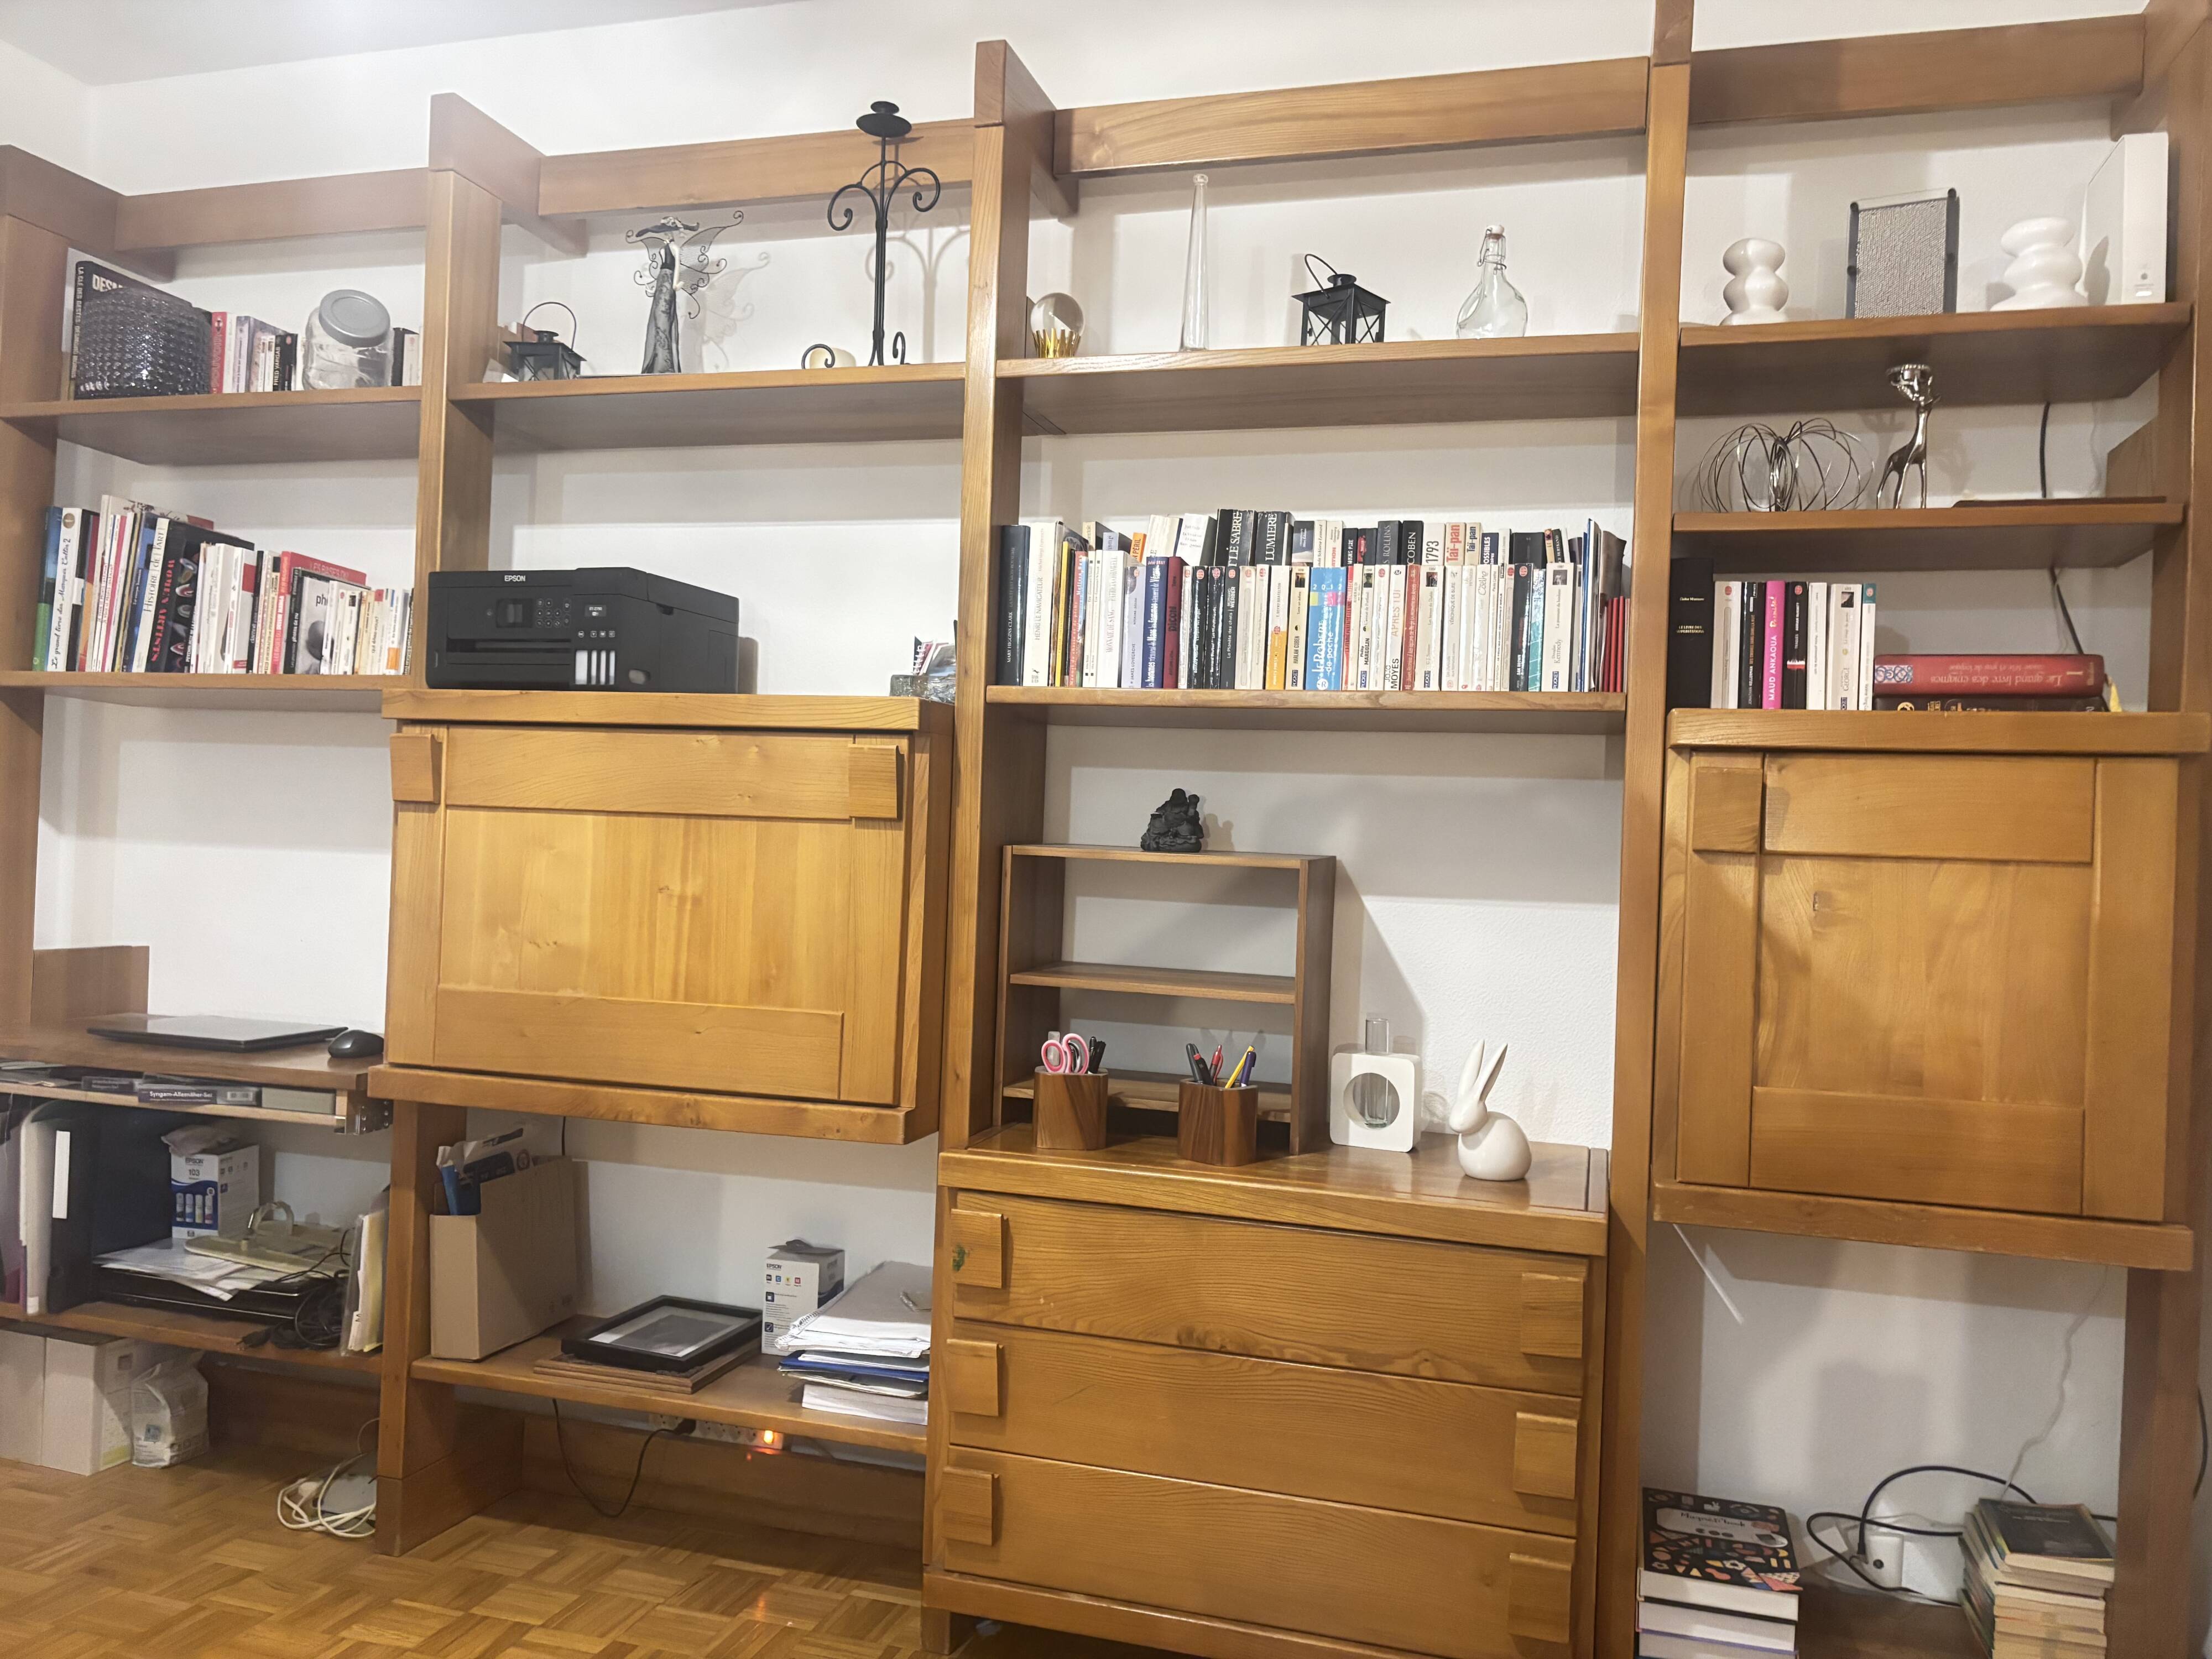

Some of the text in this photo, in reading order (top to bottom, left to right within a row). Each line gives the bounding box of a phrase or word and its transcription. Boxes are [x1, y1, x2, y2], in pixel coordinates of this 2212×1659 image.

[1230, 512, 1242, 544] SABRE
[1383, 525, 1391, 556] ROLLINS
[1467, 526, 1477, 552] Taï-pan
[1133, 539, 1141, 554] PÉRIL
[1407, 532, 1416, 564] COBEN
[1426, 540, 1439, 564] 1793
[1446, 525, 1462, 562] Taï-pan
[51, 656, 58, 669] Le
[58, 568, 67, 601] Marques
[1325, 662, 1332, 672] de
[1769, 635, 1777, 674] ANKAOUA
[1145, 662, 1156, 682] hommes
[1391, 658, 1400, 688] MOYES
[1972, 675, 1989, 685] des
[2015, 671, 2043, 686] grand
